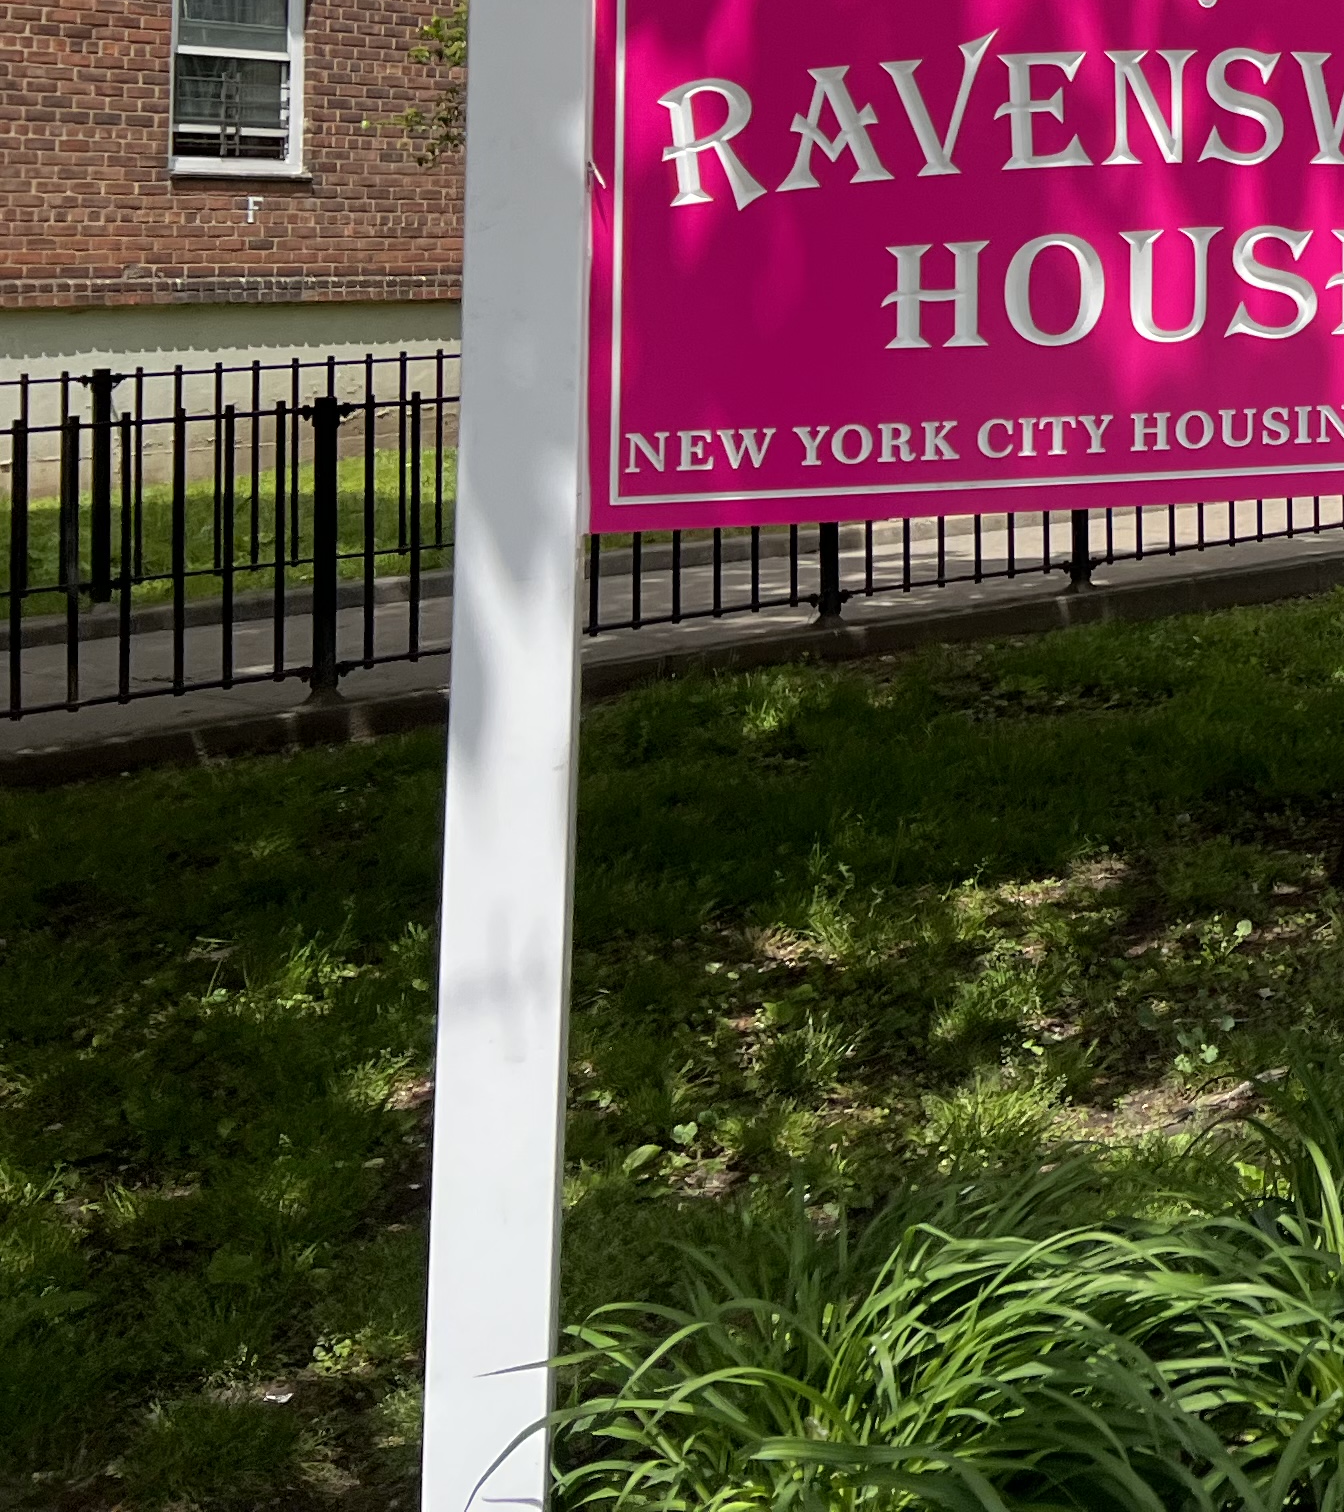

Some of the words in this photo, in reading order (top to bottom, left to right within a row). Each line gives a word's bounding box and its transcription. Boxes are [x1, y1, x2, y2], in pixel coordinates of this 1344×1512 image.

[247, 196, 264, 224] F
[624, 427, 777, 473] NEW
[792, 420, 960, 466] YORK
[977, 414, 1114, 458] CITY
